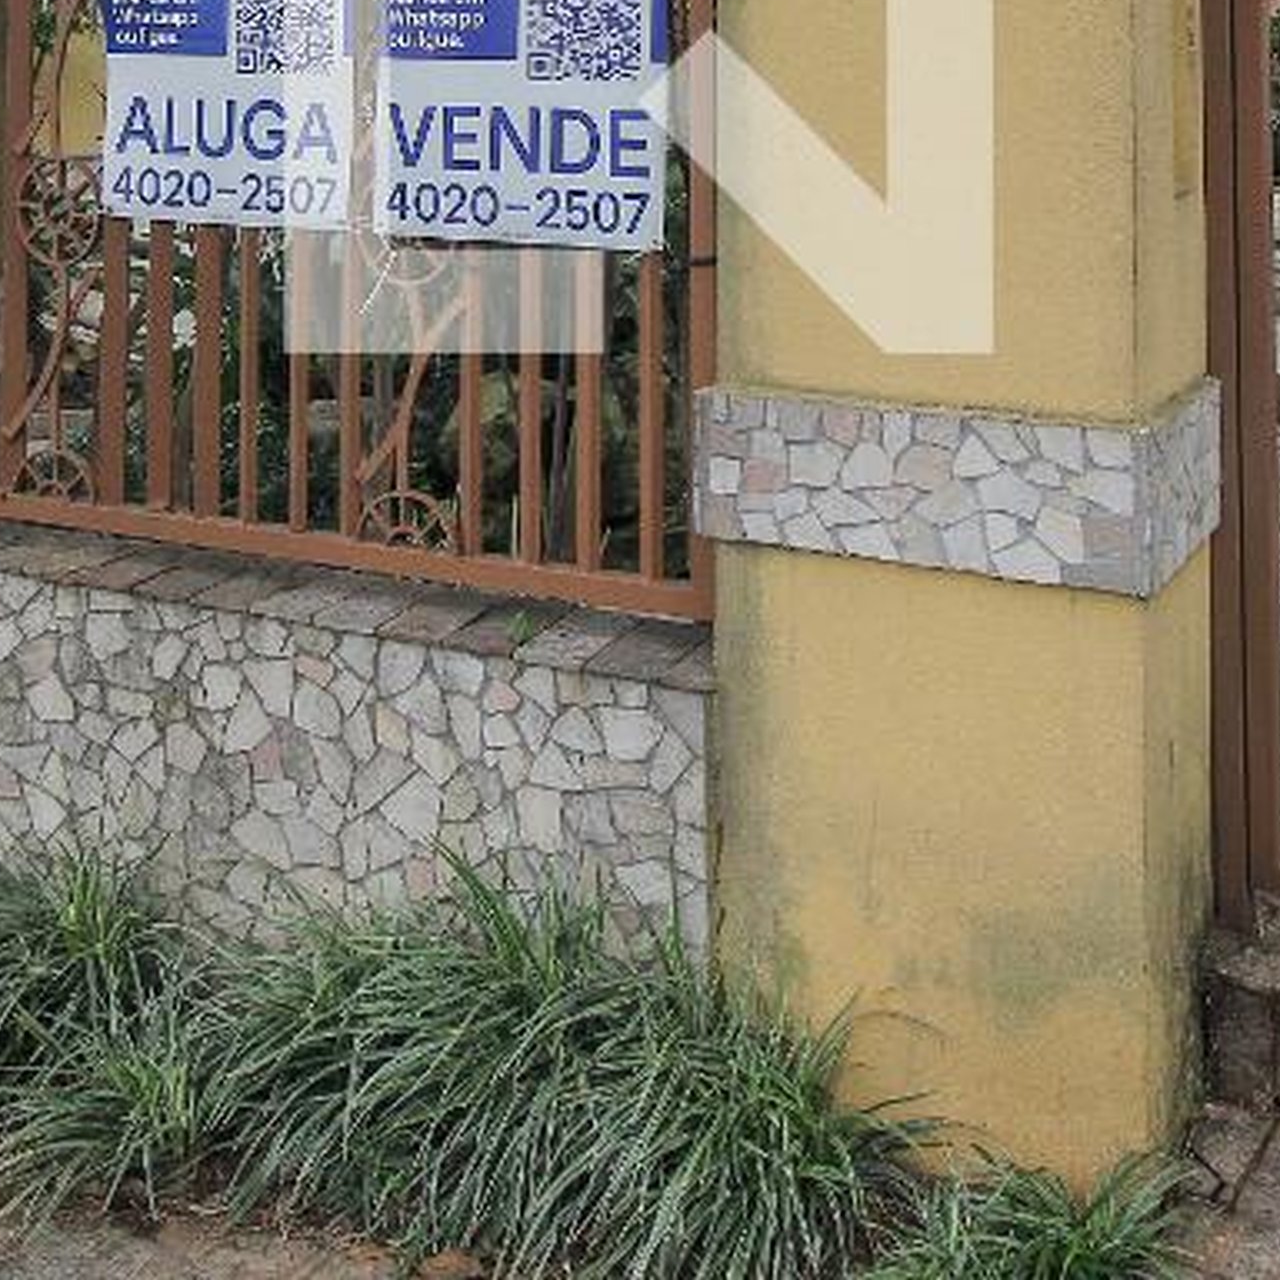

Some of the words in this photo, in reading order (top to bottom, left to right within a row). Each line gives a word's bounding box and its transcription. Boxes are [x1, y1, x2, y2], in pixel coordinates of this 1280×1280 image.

[116, 95, 338, 164] ALUGA
[389, 103, 651, 177] VENDE
[113, 166, 338, 214] 4020-2507
[387, 183, 651, 234] 4020-2507
